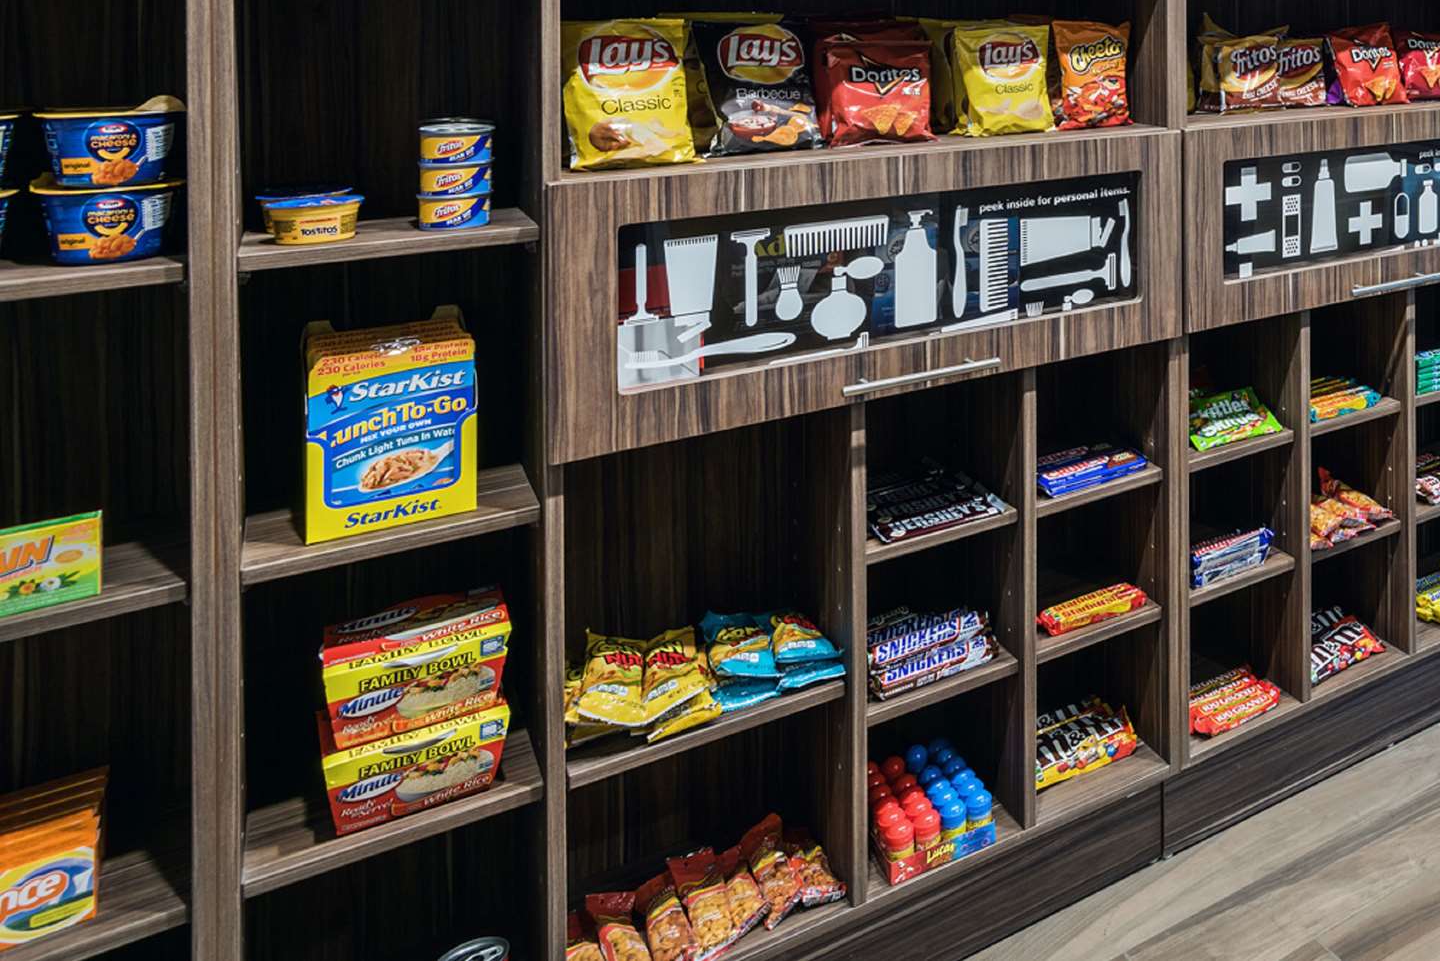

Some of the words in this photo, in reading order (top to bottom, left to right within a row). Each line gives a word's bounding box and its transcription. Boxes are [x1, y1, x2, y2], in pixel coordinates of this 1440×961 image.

[588, 38, 671, 75] Lay's
[727, 35, 798, 67] Lay's
[983, 41, 1033, 67] Lay's
[1231, 44, 1278, 79] Fritos
[1277, 46, 1322, 77] Fritos
[601, 95, 672, 114] Classic
[736, 88, 801, 101] Barbecue
[995, 82, 1033, 96] Classic
[979, 200, 1003, 215] peek
[1006, 198, 1035, 209] inside
[1037, 195, 1051, 205] for
[1053, 190, 1098, 206] personal
[349, 369, 467, 402] StarKist
[335, 451, 366, 469] Chunk
[368, 442, 395, 457] Light
[396, 435, 420, 447] Tuna
[344, 498, 440, 529] StarKist
[878, 619, 957, 663] SNICKERS
[359, 669, 424, 694] FAMILY
[427, 651, 476, 676] BOWL
[886, 645, 966, 681] SNICKERS
[337, 688, 403, 720] Minute
[358, 753, 423, 780] FAMILY
[427, 735, 476, 761] BOWL
[336, 771, 404, 804] Minute
